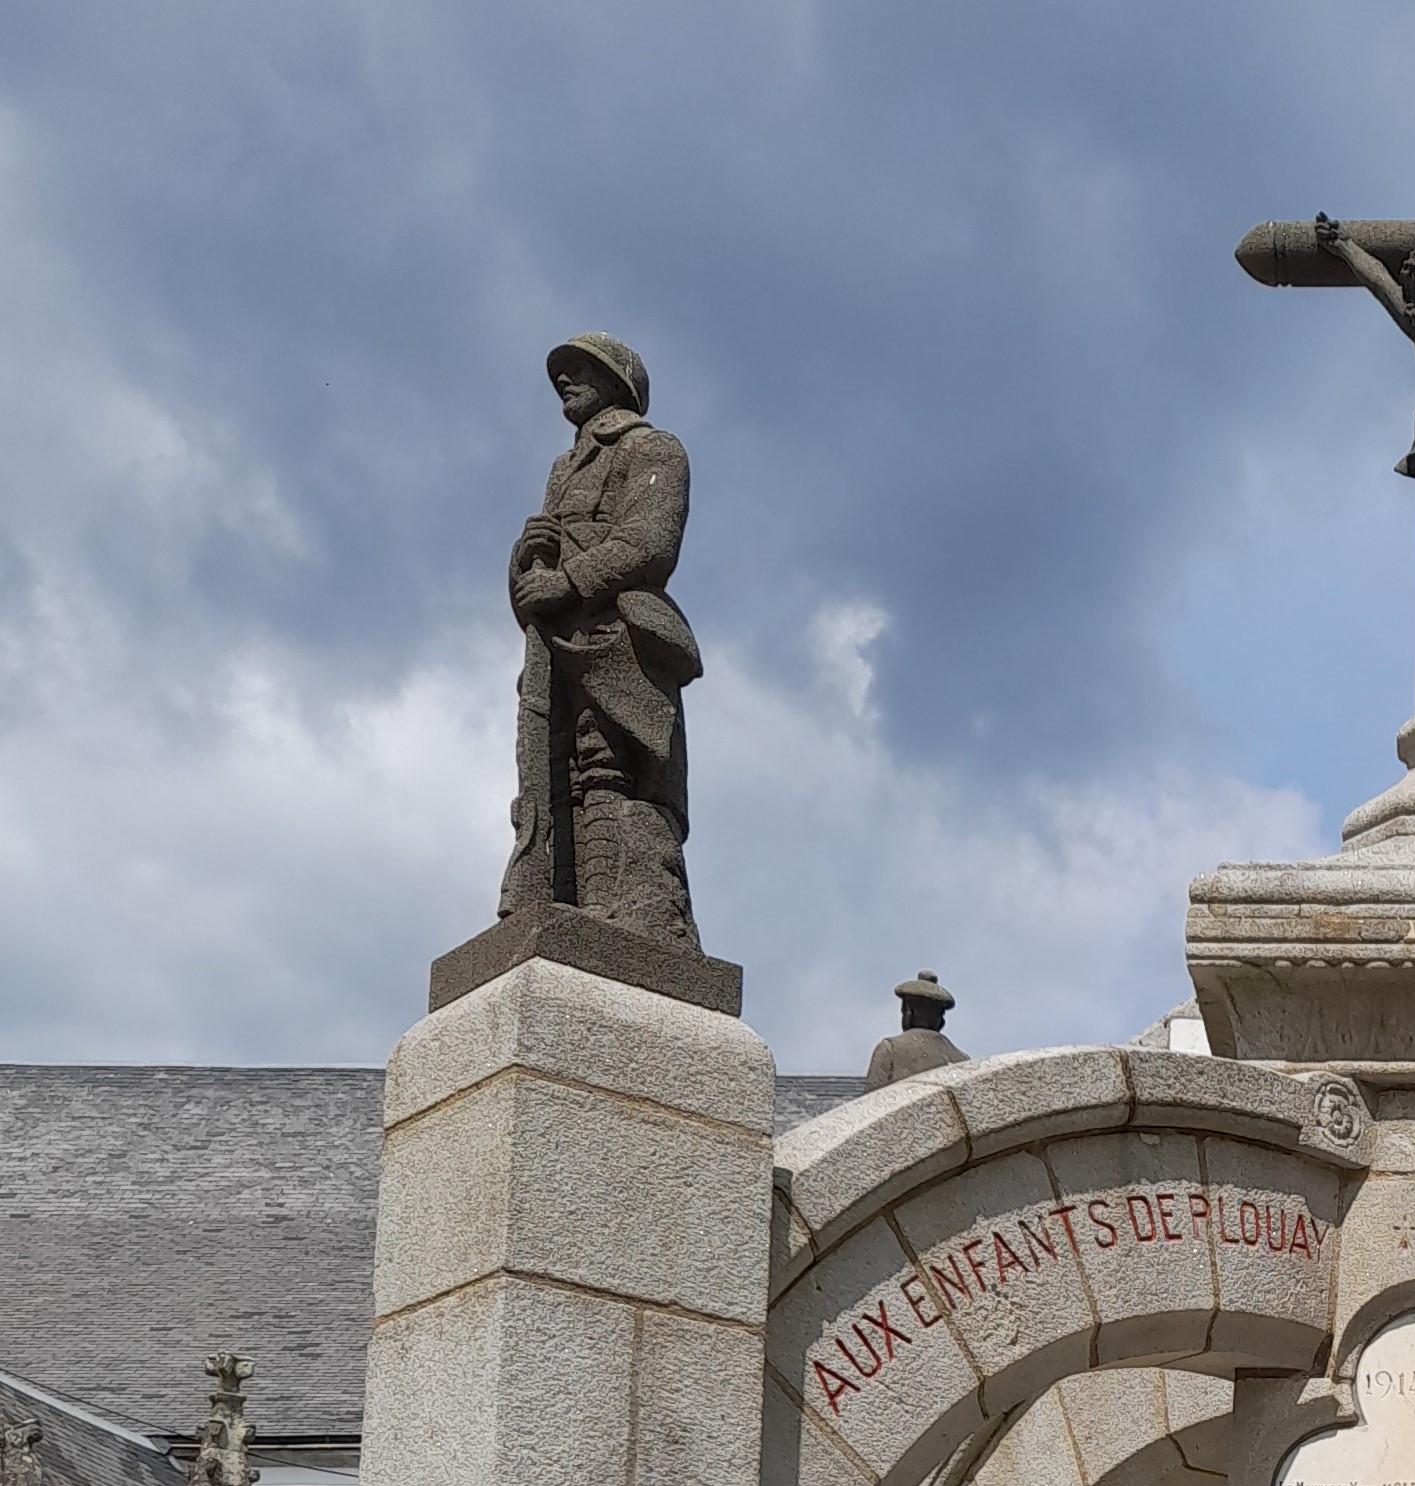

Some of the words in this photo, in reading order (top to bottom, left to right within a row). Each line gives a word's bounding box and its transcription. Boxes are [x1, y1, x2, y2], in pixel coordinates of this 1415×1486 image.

[813, 1300, 911, 1416] AUX
[900, 1200, 1117, 1328] ENFANTS
[1127, 1194, 1182, 1242] DE
[1189, 1194, 1330, 1263] PLOUAY
